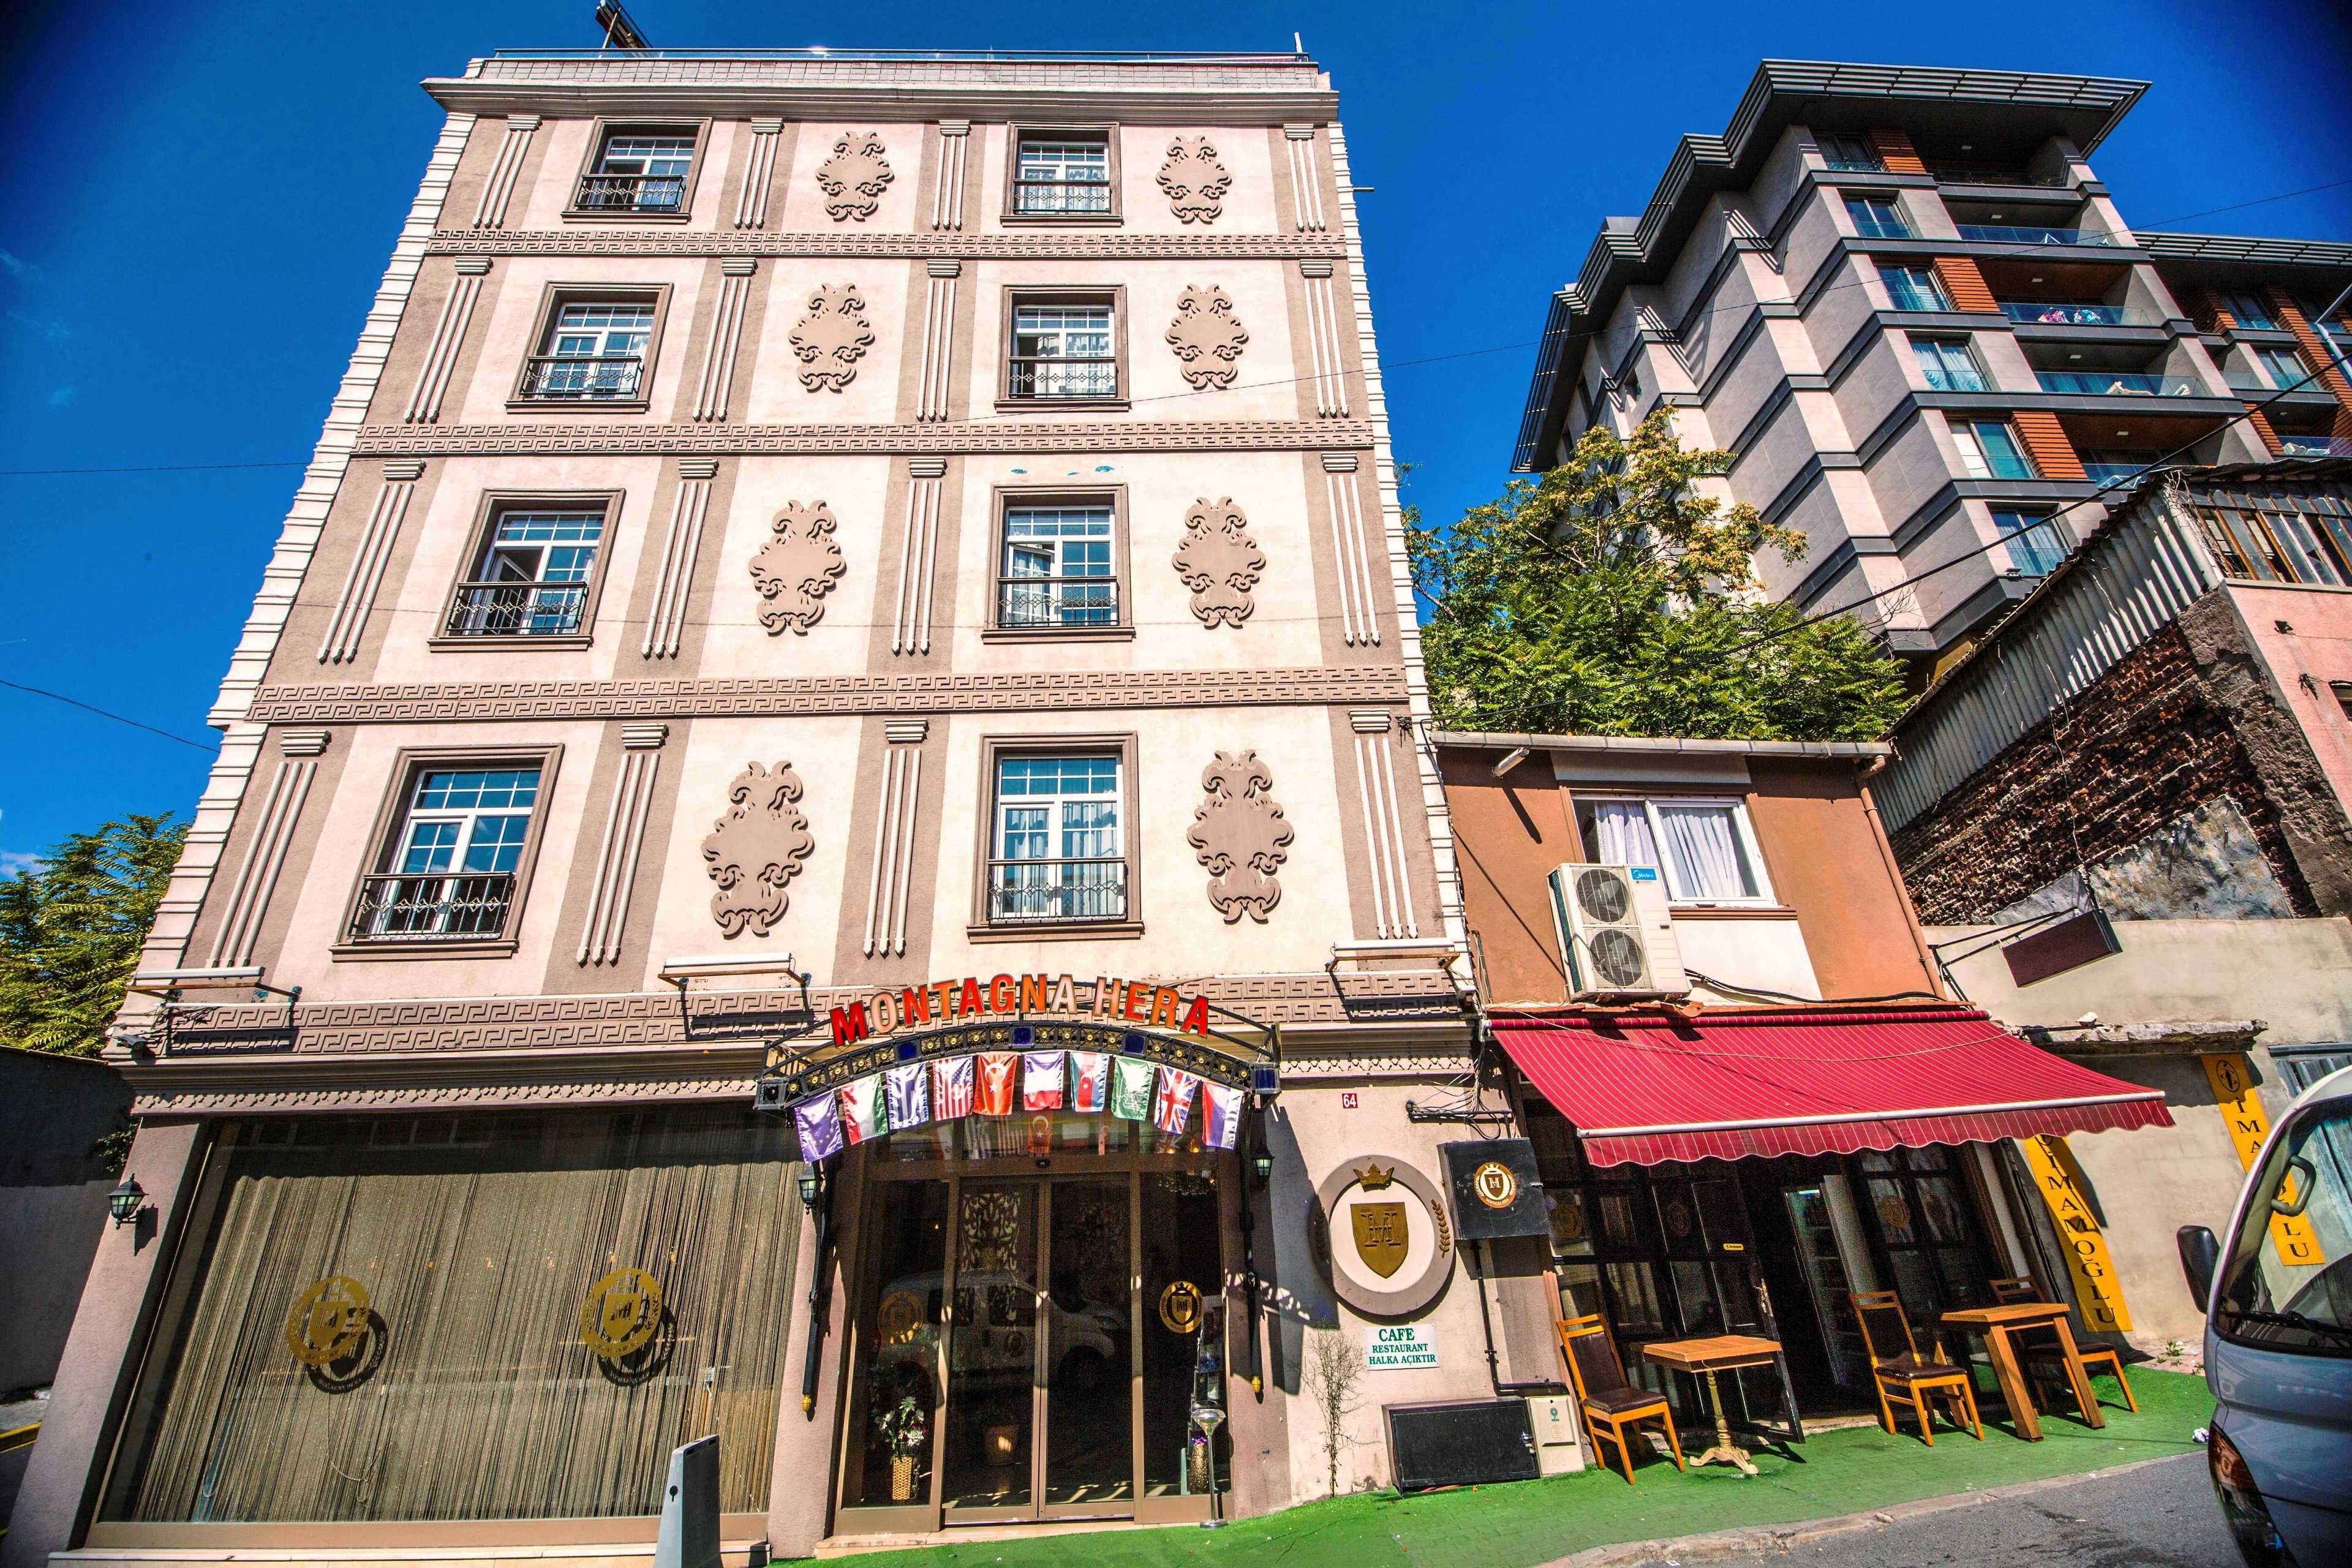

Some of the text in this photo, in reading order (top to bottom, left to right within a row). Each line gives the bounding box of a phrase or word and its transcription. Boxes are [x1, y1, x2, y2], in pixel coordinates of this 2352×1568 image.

[829, 974, 1208, 1047] MONTAGNA HERA
[1343, 1094, 1356, 1107] 64
[1379, 1328, 1415, 1341] CAFE
[1372, 1343, 1428, 1353] RESTAURANT
[1369, 1354, 1436, 1365] HALKA AÇIKTIR
